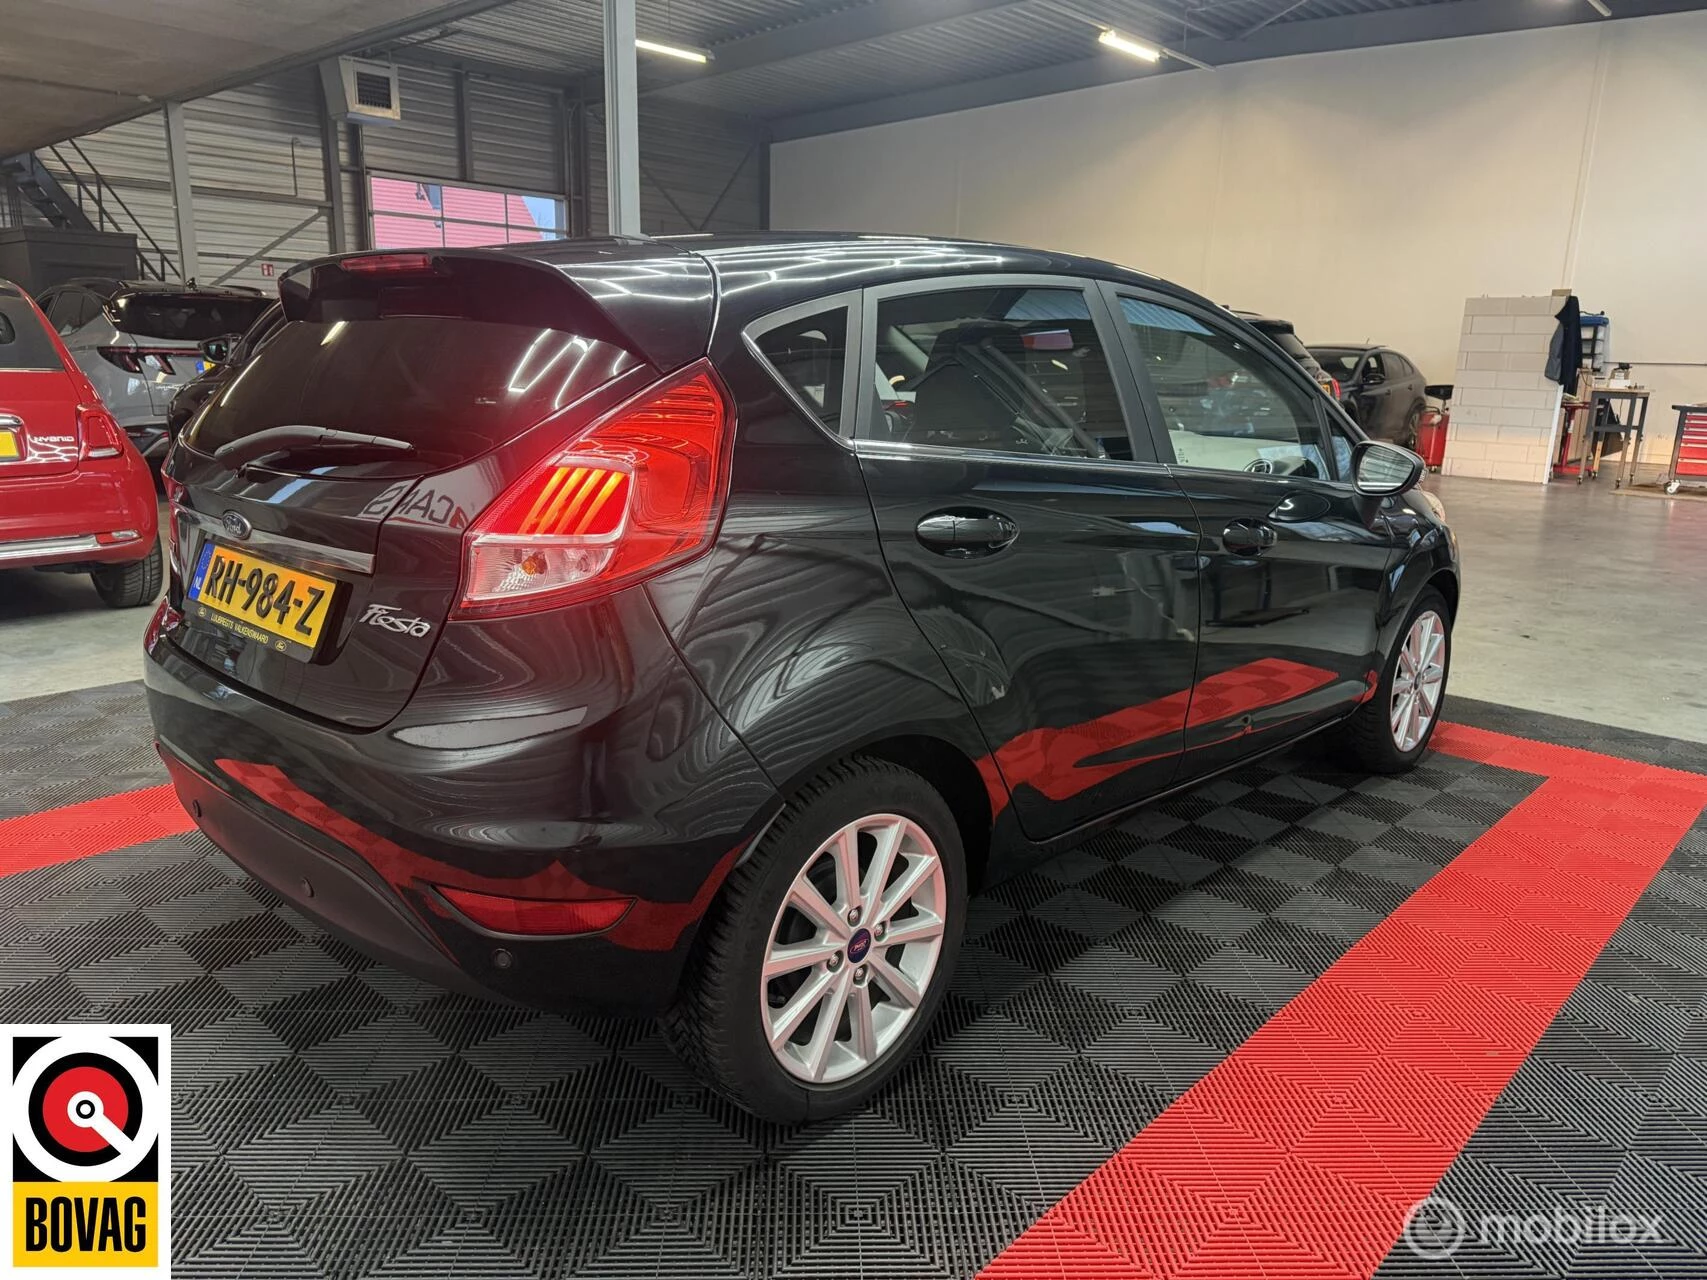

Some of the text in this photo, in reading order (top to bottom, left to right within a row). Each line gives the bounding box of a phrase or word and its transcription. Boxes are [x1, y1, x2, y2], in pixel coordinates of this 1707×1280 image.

[33, 435, 75, 443] HYBRID
[204, 553, 326, 637] RH-984-Z
[358, 603, 431, 638] Fiesta
